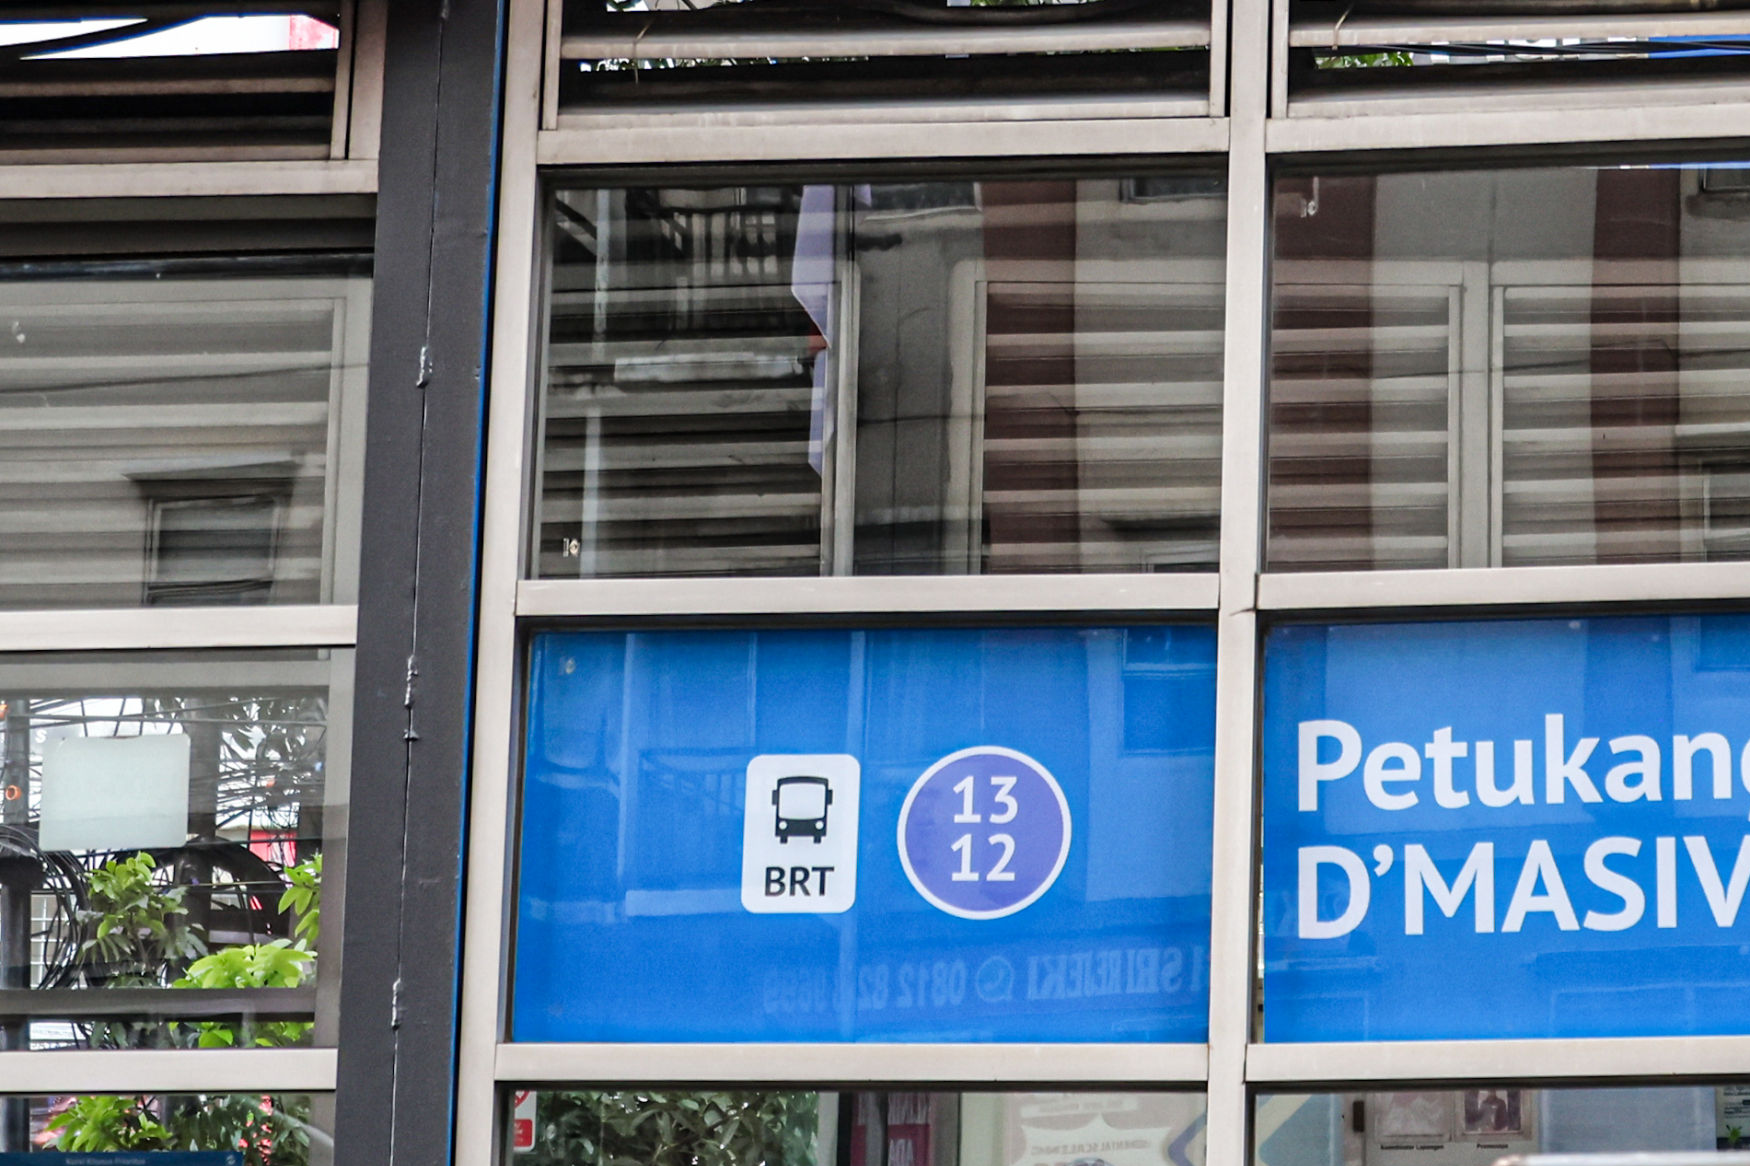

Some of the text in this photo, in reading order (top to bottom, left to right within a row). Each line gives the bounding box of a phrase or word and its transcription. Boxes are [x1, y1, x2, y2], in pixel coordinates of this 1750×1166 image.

[952, 776, 1019, 824] 13
[764, 866, 834, 896] BRT
[950, 834, 1016, 882] 12
